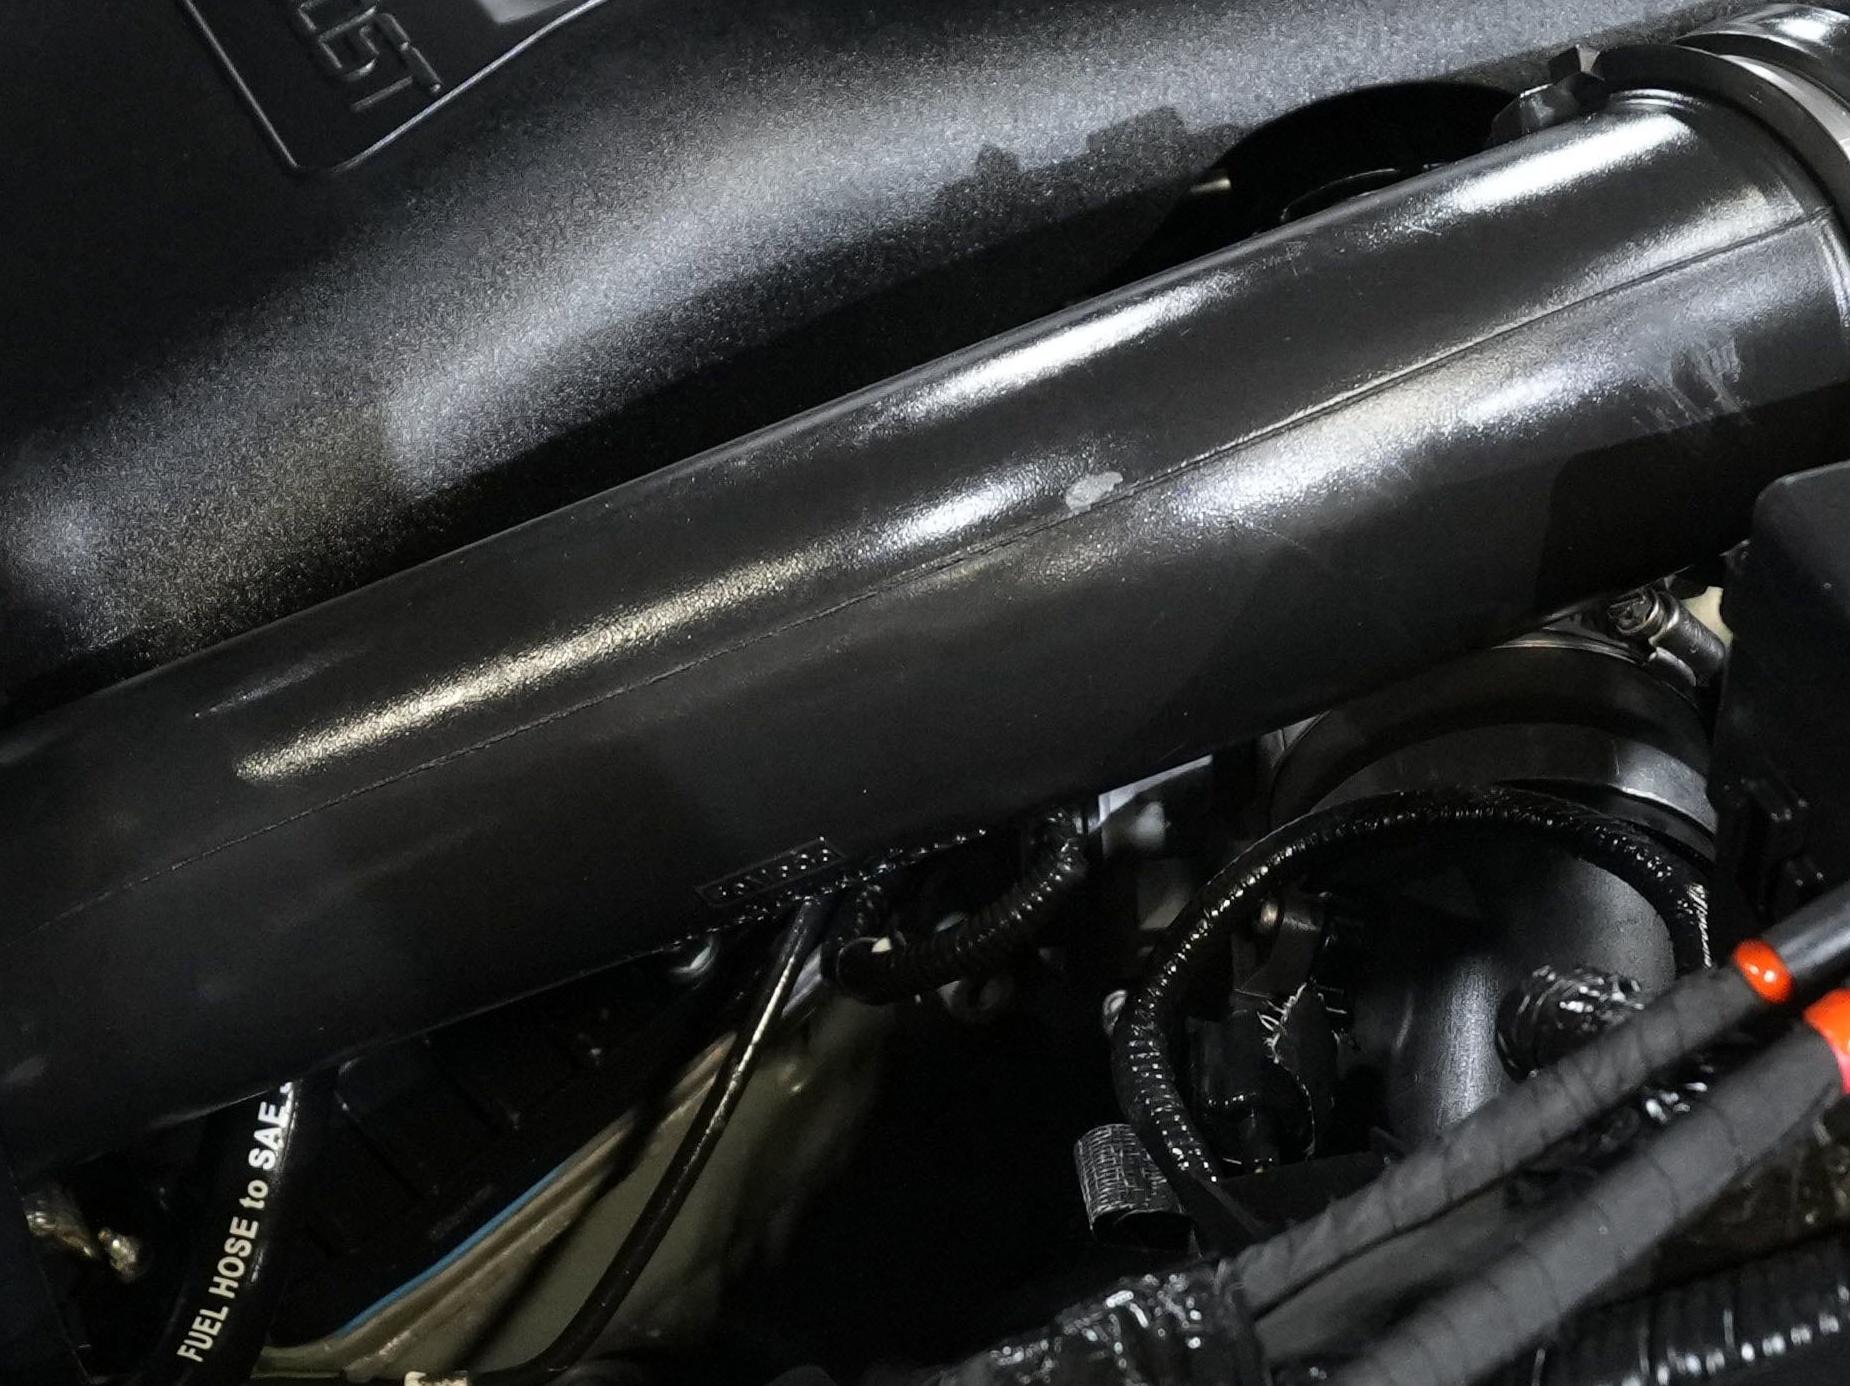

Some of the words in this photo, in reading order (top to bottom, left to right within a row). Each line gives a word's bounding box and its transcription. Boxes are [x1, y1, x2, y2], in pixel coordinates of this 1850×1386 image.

[248, 1101, 289, 1170] SAE
[239, 1179, 269, 1209] to
[209, 1216, 259, 1299] HOSE
[177, 1305, 229, 1362] FUEL
